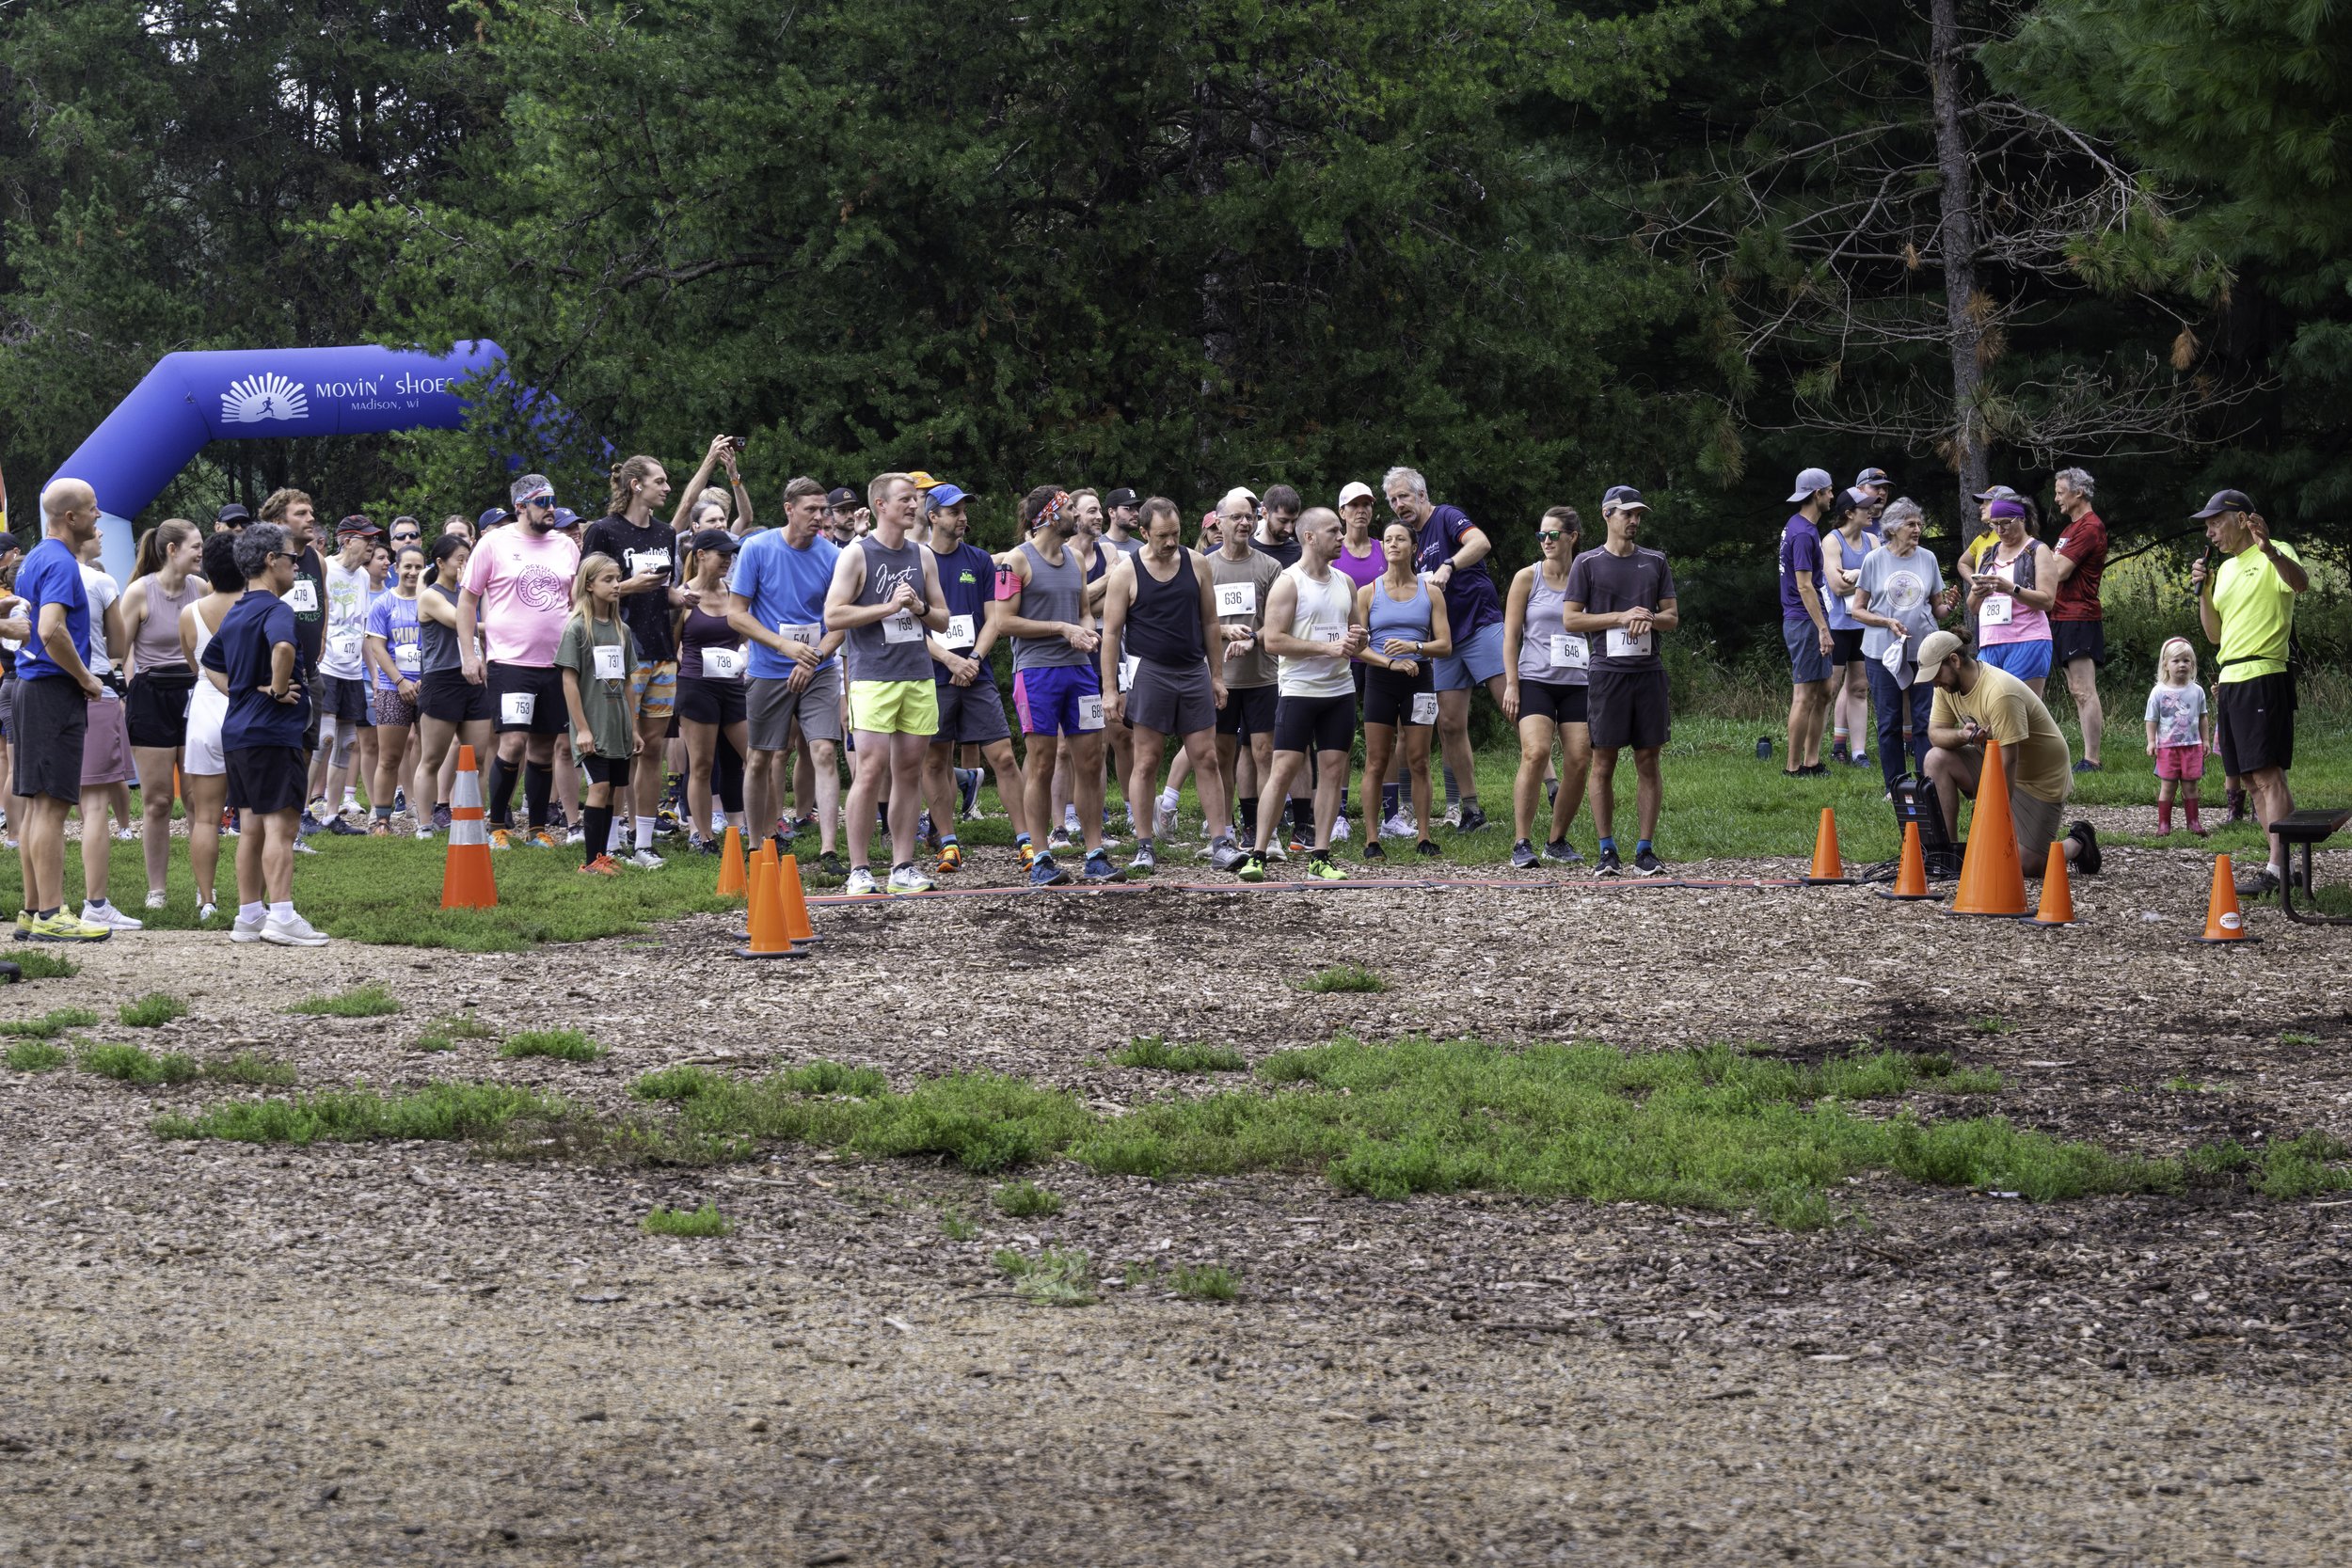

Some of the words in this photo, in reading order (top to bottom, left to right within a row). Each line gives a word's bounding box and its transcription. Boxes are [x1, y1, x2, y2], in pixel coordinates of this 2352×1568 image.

[876, 563, 917, 594] Just
[294, 589, 308, 602] 479
[1225, 592, 1242, 605] 636
[1987, 604, 2000, 616] 283
[896, 617, 913, 631] 759
[946, 625, 963, 639] 646
[343, 642, 356, 654] 472
[1565, 643, 1580, 657] 648
[716, 655, 732, 668] 738
[516, 702, 531, 715] 753
